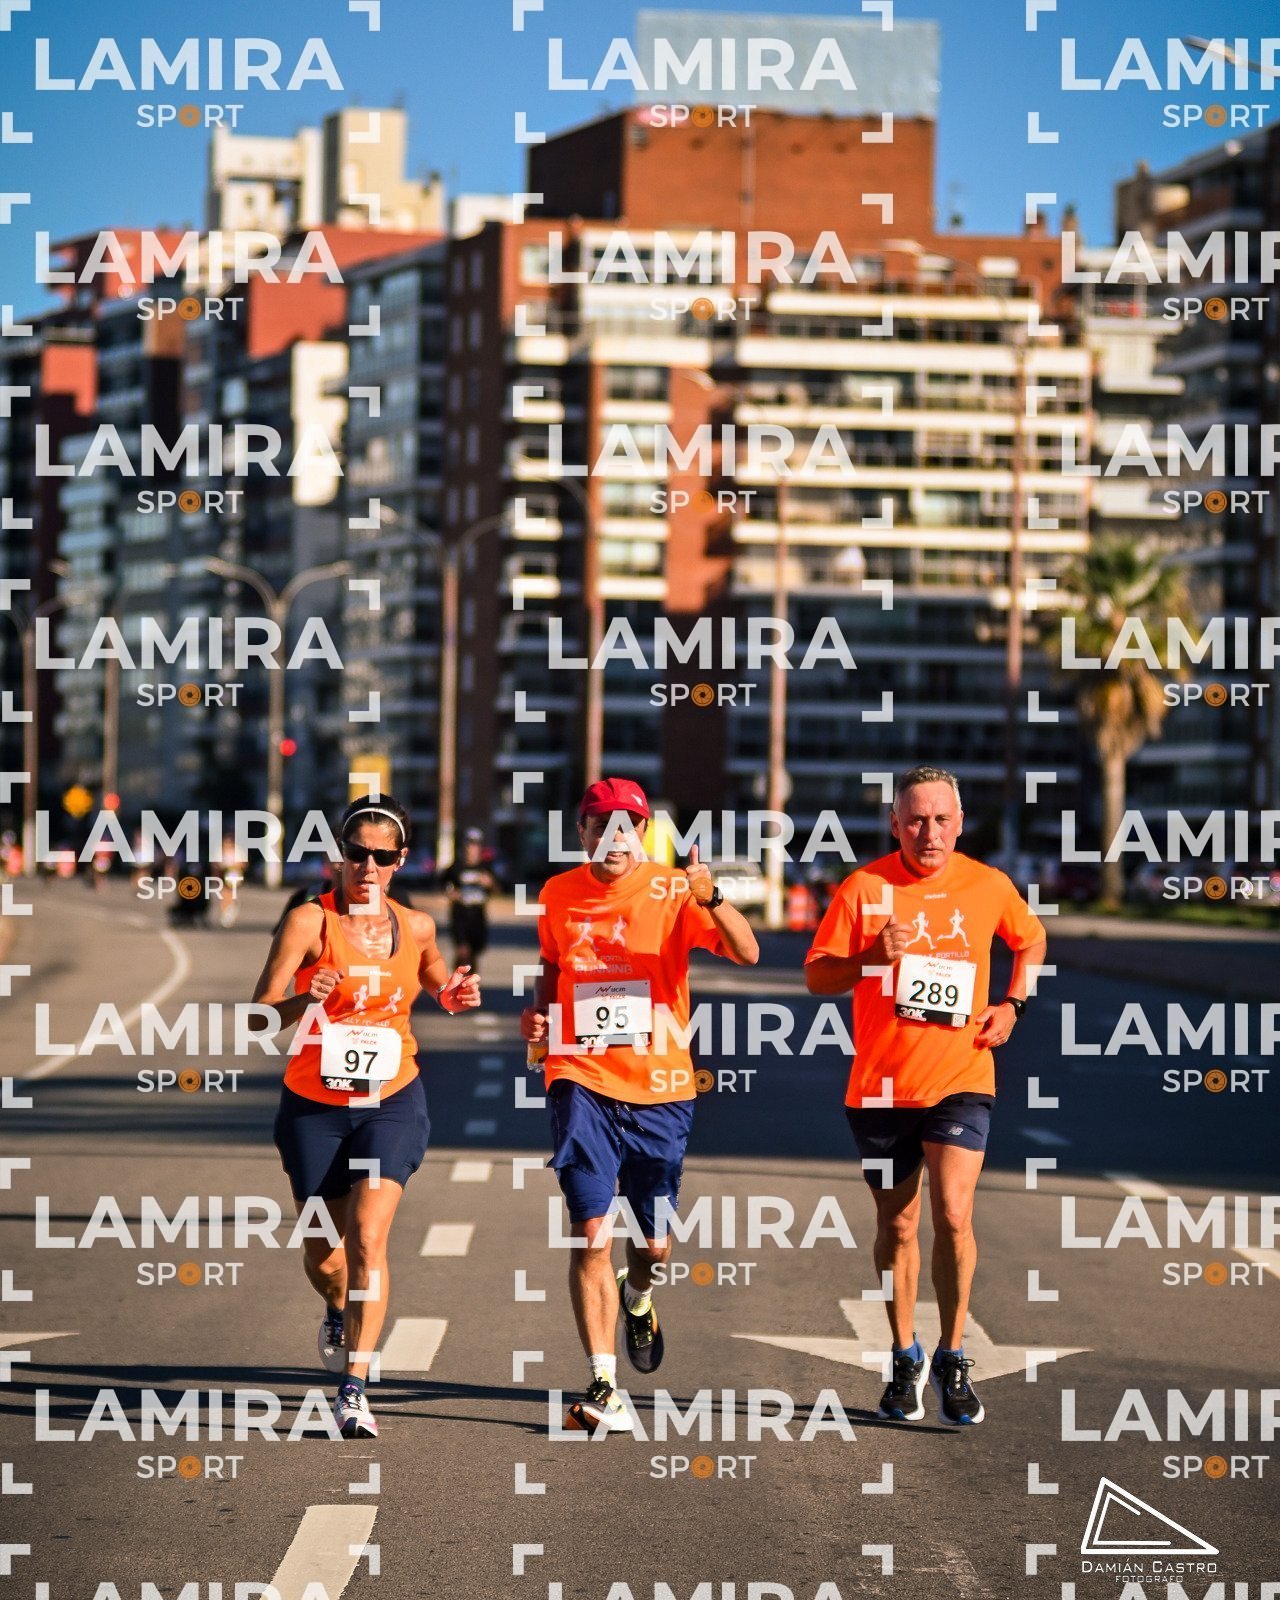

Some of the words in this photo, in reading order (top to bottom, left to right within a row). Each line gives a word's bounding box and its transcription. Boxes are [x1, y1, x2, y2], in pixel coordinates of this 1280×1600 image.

[909, 980, 959, 1007] 289
[596, 1005, 629, 1030] 95
[344, 1049, 378, 1074] 97
